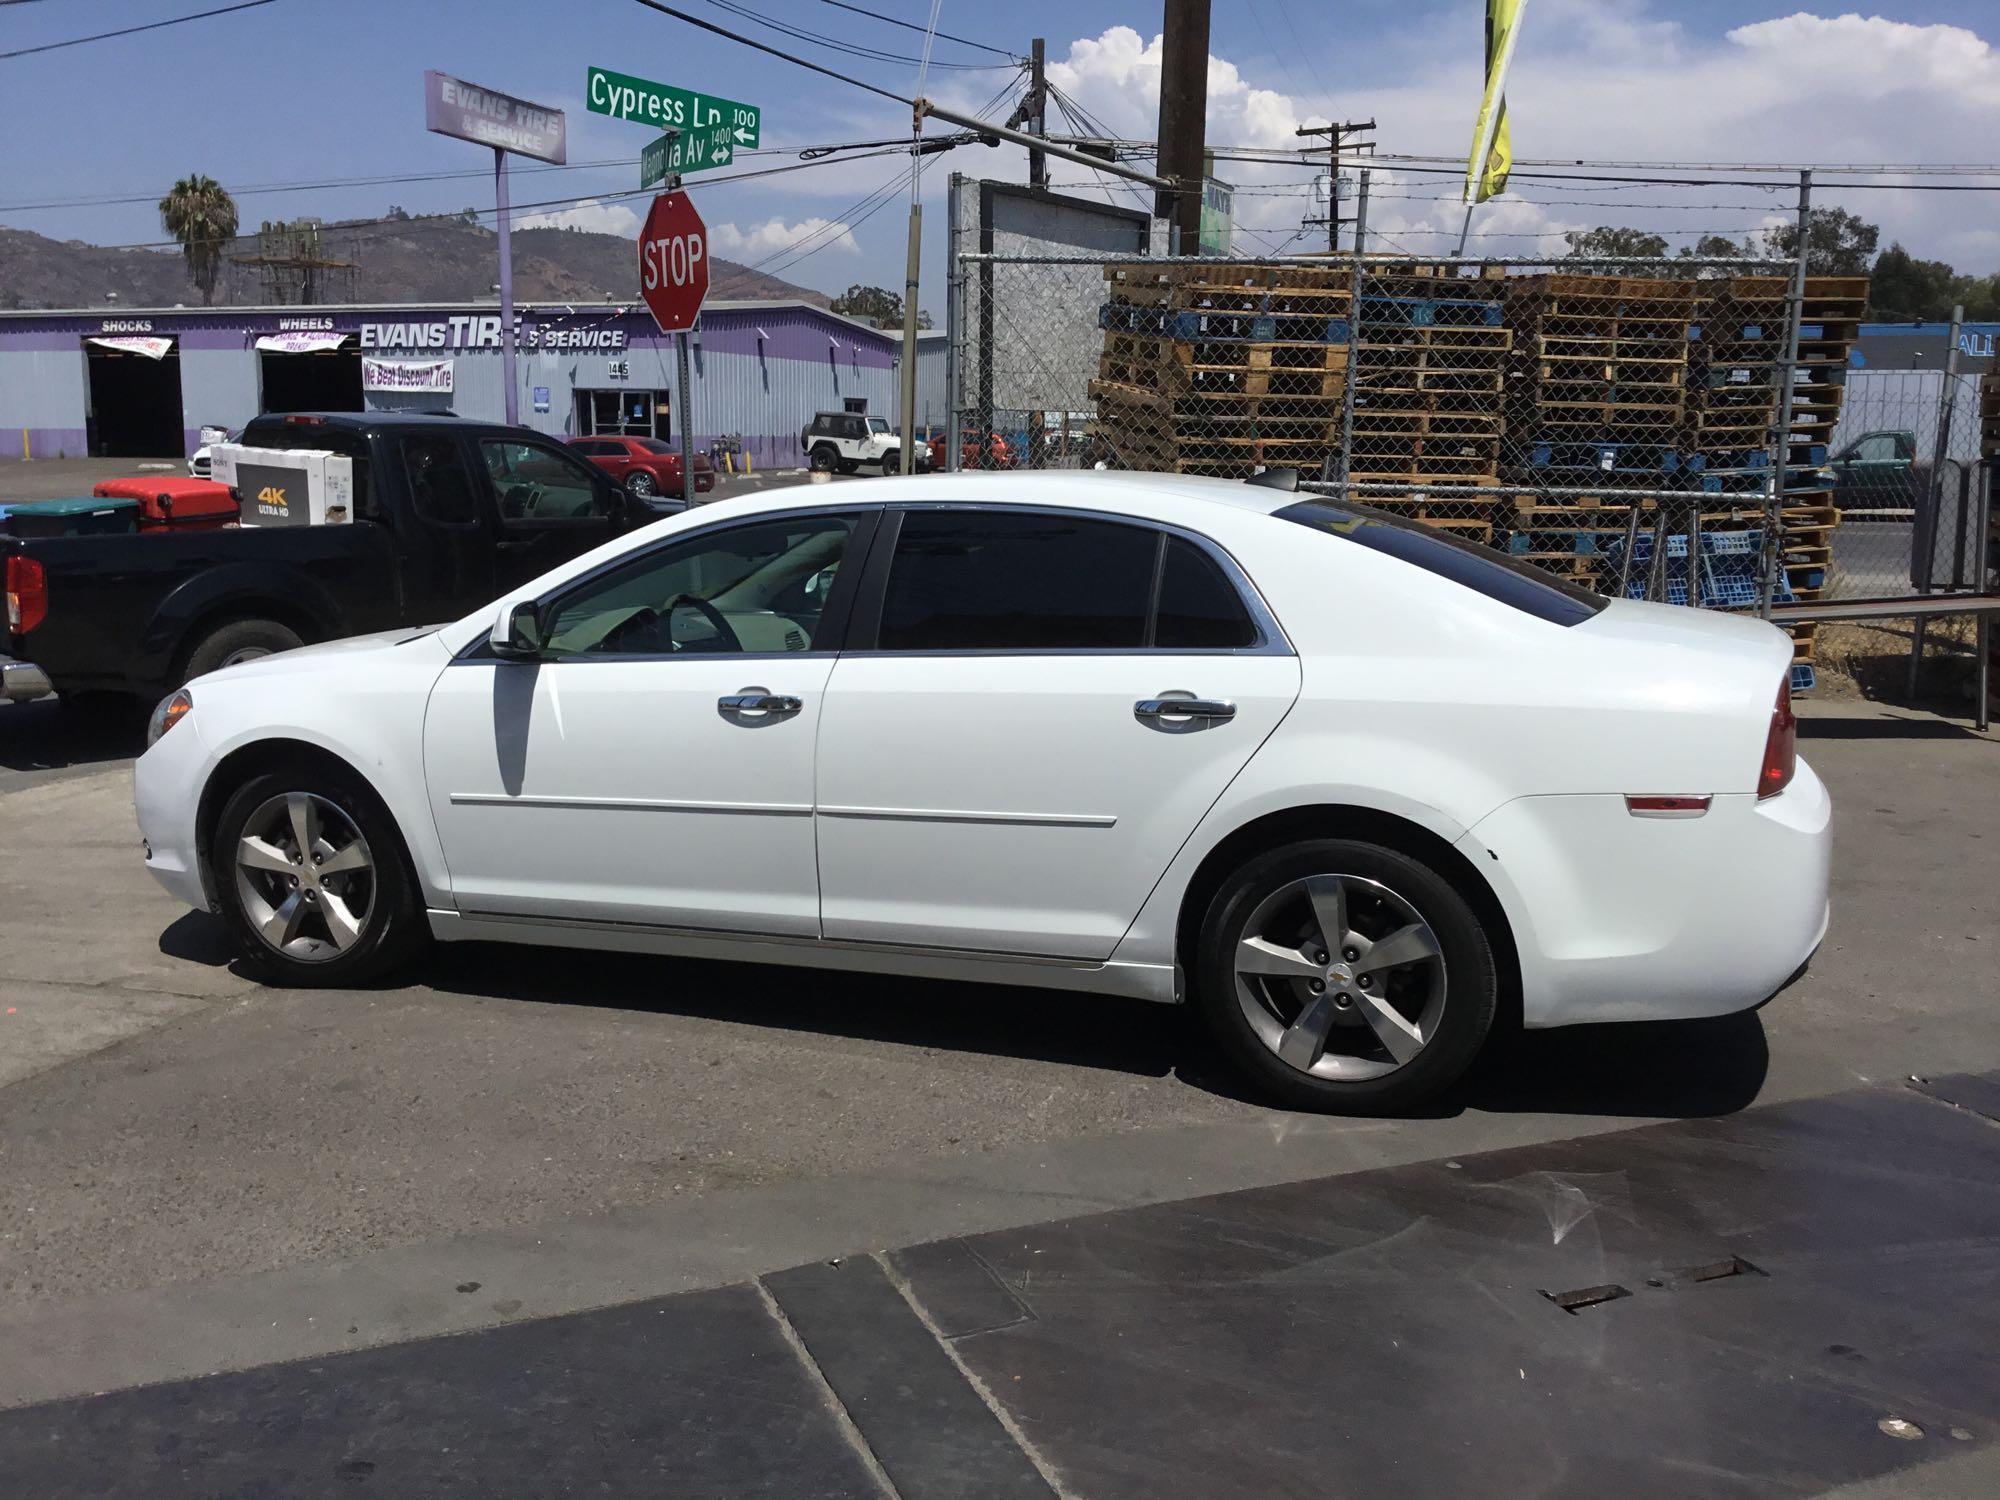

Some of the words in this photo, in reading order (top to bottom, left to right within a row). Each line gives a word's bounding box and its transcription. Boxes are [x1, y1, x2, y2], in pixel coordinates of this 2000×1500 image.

[441, 80, 510, 121] EVANS
[514, 104, 560, 136] TIRE
[591, 72, 685, 124] Cypress
[693, 96, 721, 128] Ln
[733, 108, 756, 128] 100
[462, 114, 473, 132] &
[478, 119, 544, 152] SERVICE
[711, 126, 732, 147] 1400
[685, 133, 705, 165] Av
[644, 233, 703, 290] STOP
[101, 319, 153, 333] SHOCKS
[279, 317, 334, 331] WHEELS
[360, 323, 447, 348] EVANS
[545, 330, 624, 348] SERVICE
[363, 362, 376, 386] We
[377, 364, 396, 387] Beat
[397, 364, 434, 388] Discount
[434, 364, 452, 388] Tire
[608, 362, 629, 376] 1445
[257, 486, 289, 507] 4K
[258, 504, 279, 517] ULTRA
[279, 506, 290, 518] HD
